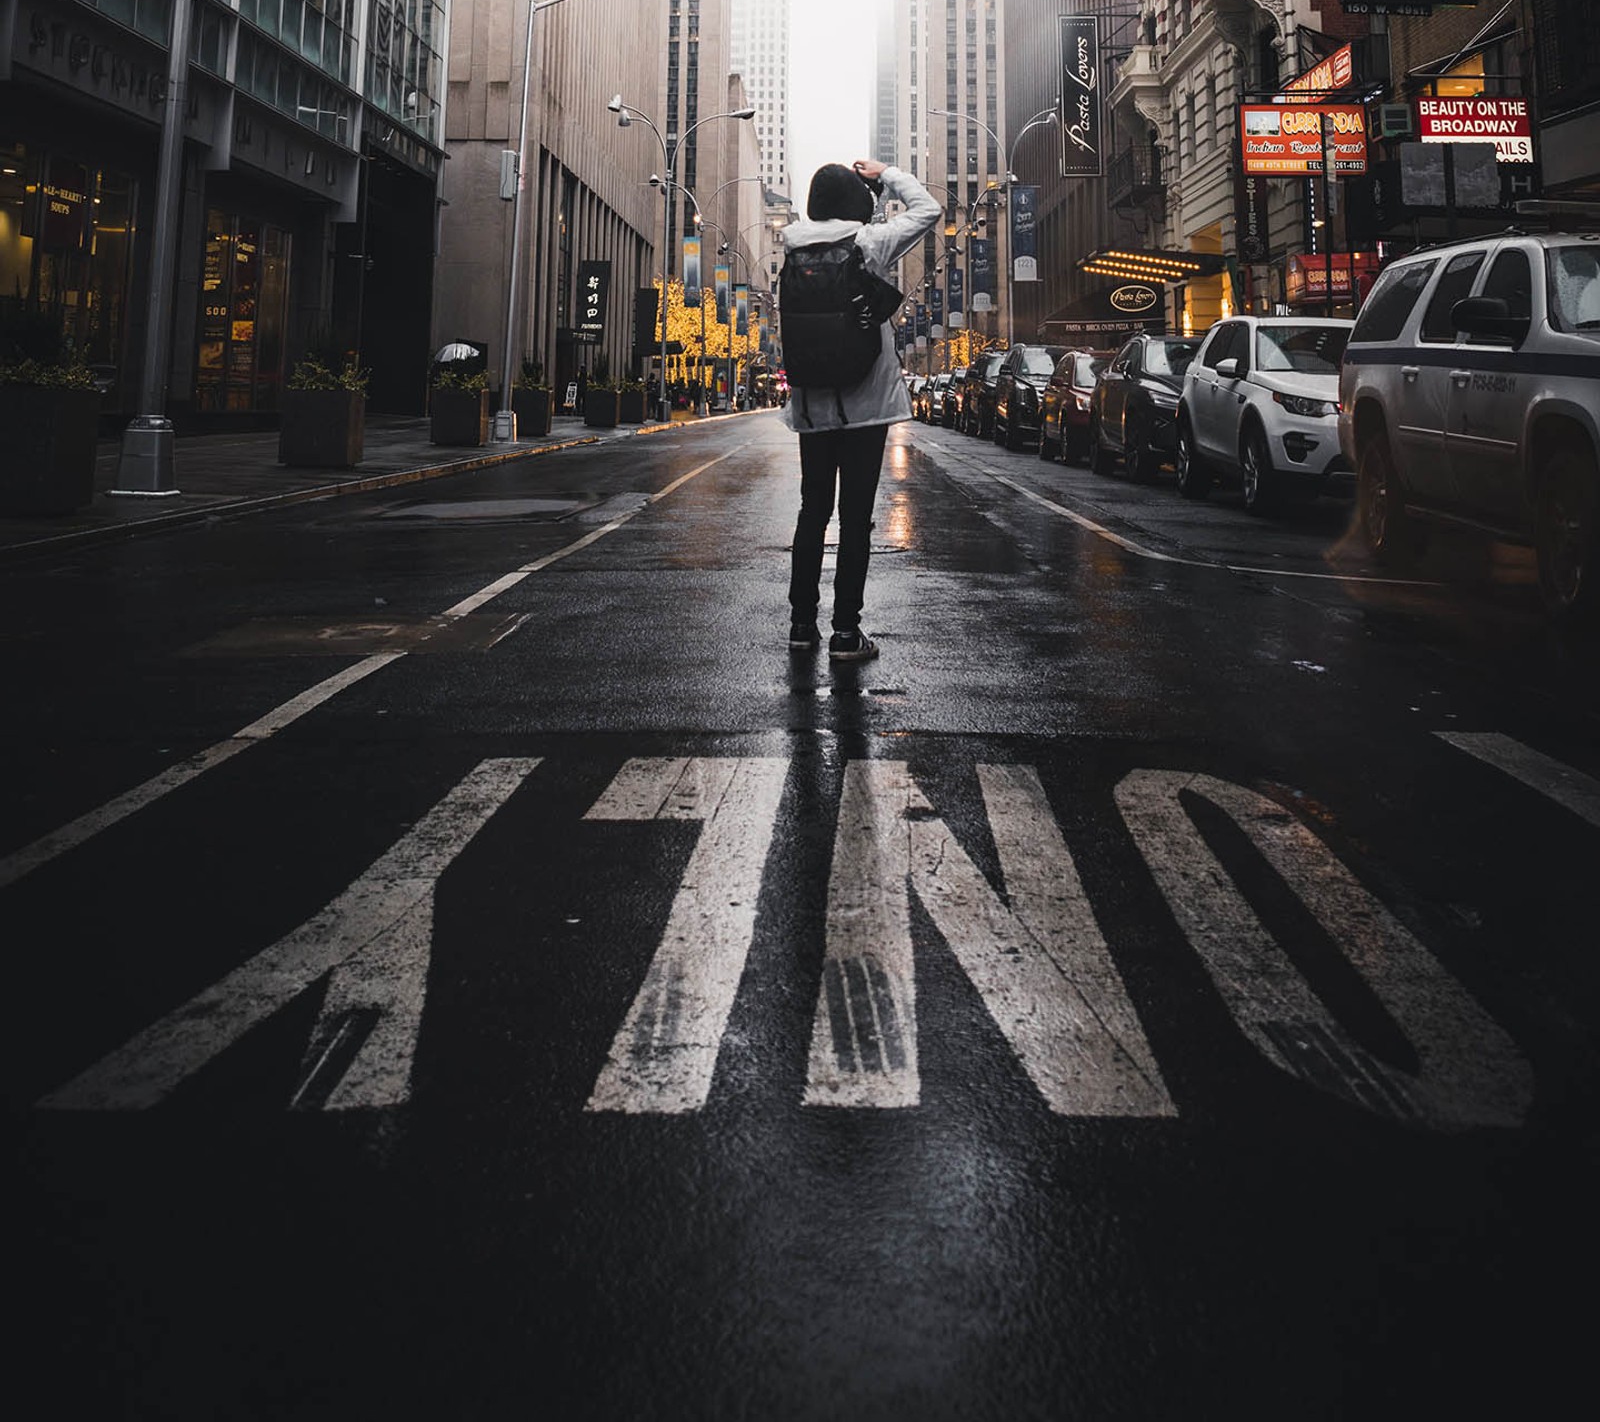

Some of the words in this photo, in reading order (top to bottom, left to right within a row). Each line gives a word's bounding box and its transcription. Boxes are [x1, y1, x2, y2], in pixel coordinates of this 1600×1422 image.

[1064, 35, 1097, 91] Lovers
[1419, 101, 1474, 116] BEAUTY
[1477, 101, 1497, 116] ON
[1500, 101, 1526, 116] THE
[1064, 94, 1096, 154] Pasta
[1325, 112, 1363, 135] NDIA
[1430, 120, 1517, 133] BROADWAY
[1246, 140, 1286, 154] Indian
[1495, 141, 1528, 155] AILS
[1283, 161, 1305, 170] STREET
[1115, 291, 1134, 303] Pasta
[1134, 289, 1154, 303] Lovers
[36, 755, 1534, 1128] ONLY
